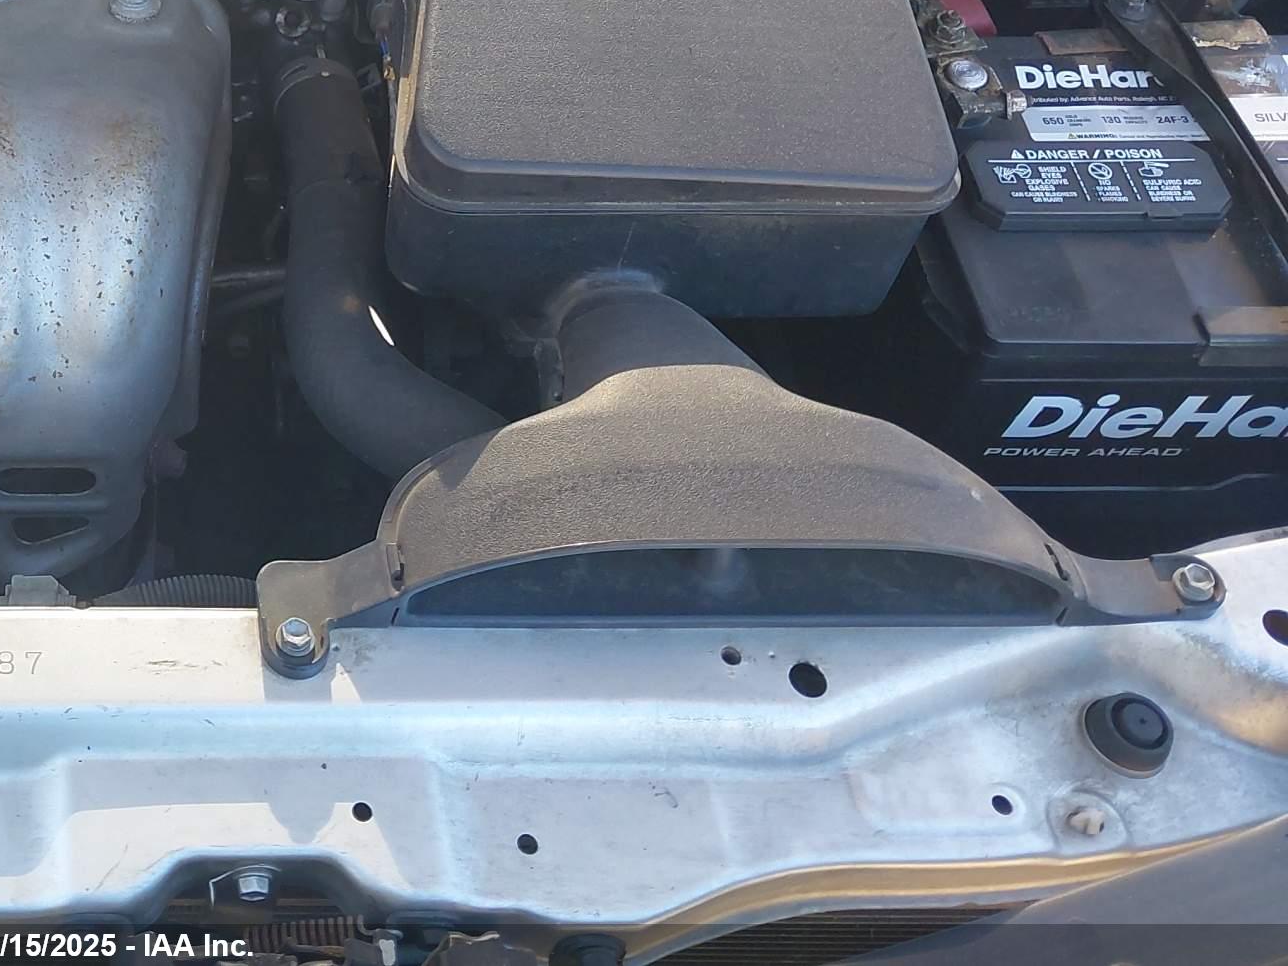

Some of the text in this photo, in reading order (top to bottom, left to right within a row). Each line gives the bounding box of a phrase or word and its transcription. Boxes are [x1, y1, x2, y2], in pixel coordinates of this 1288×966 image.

[1015, 64, 1162, 89] DieHar
[1042, 117, 1064, 125] 650
[1101, 116, 1121, 124] 130
[1025, 148, 1164, 160] DANGER / POISON
[1001, 394, 1288, 438] DieHa
[984, 447, 1184, 457] POWER AHEAD
